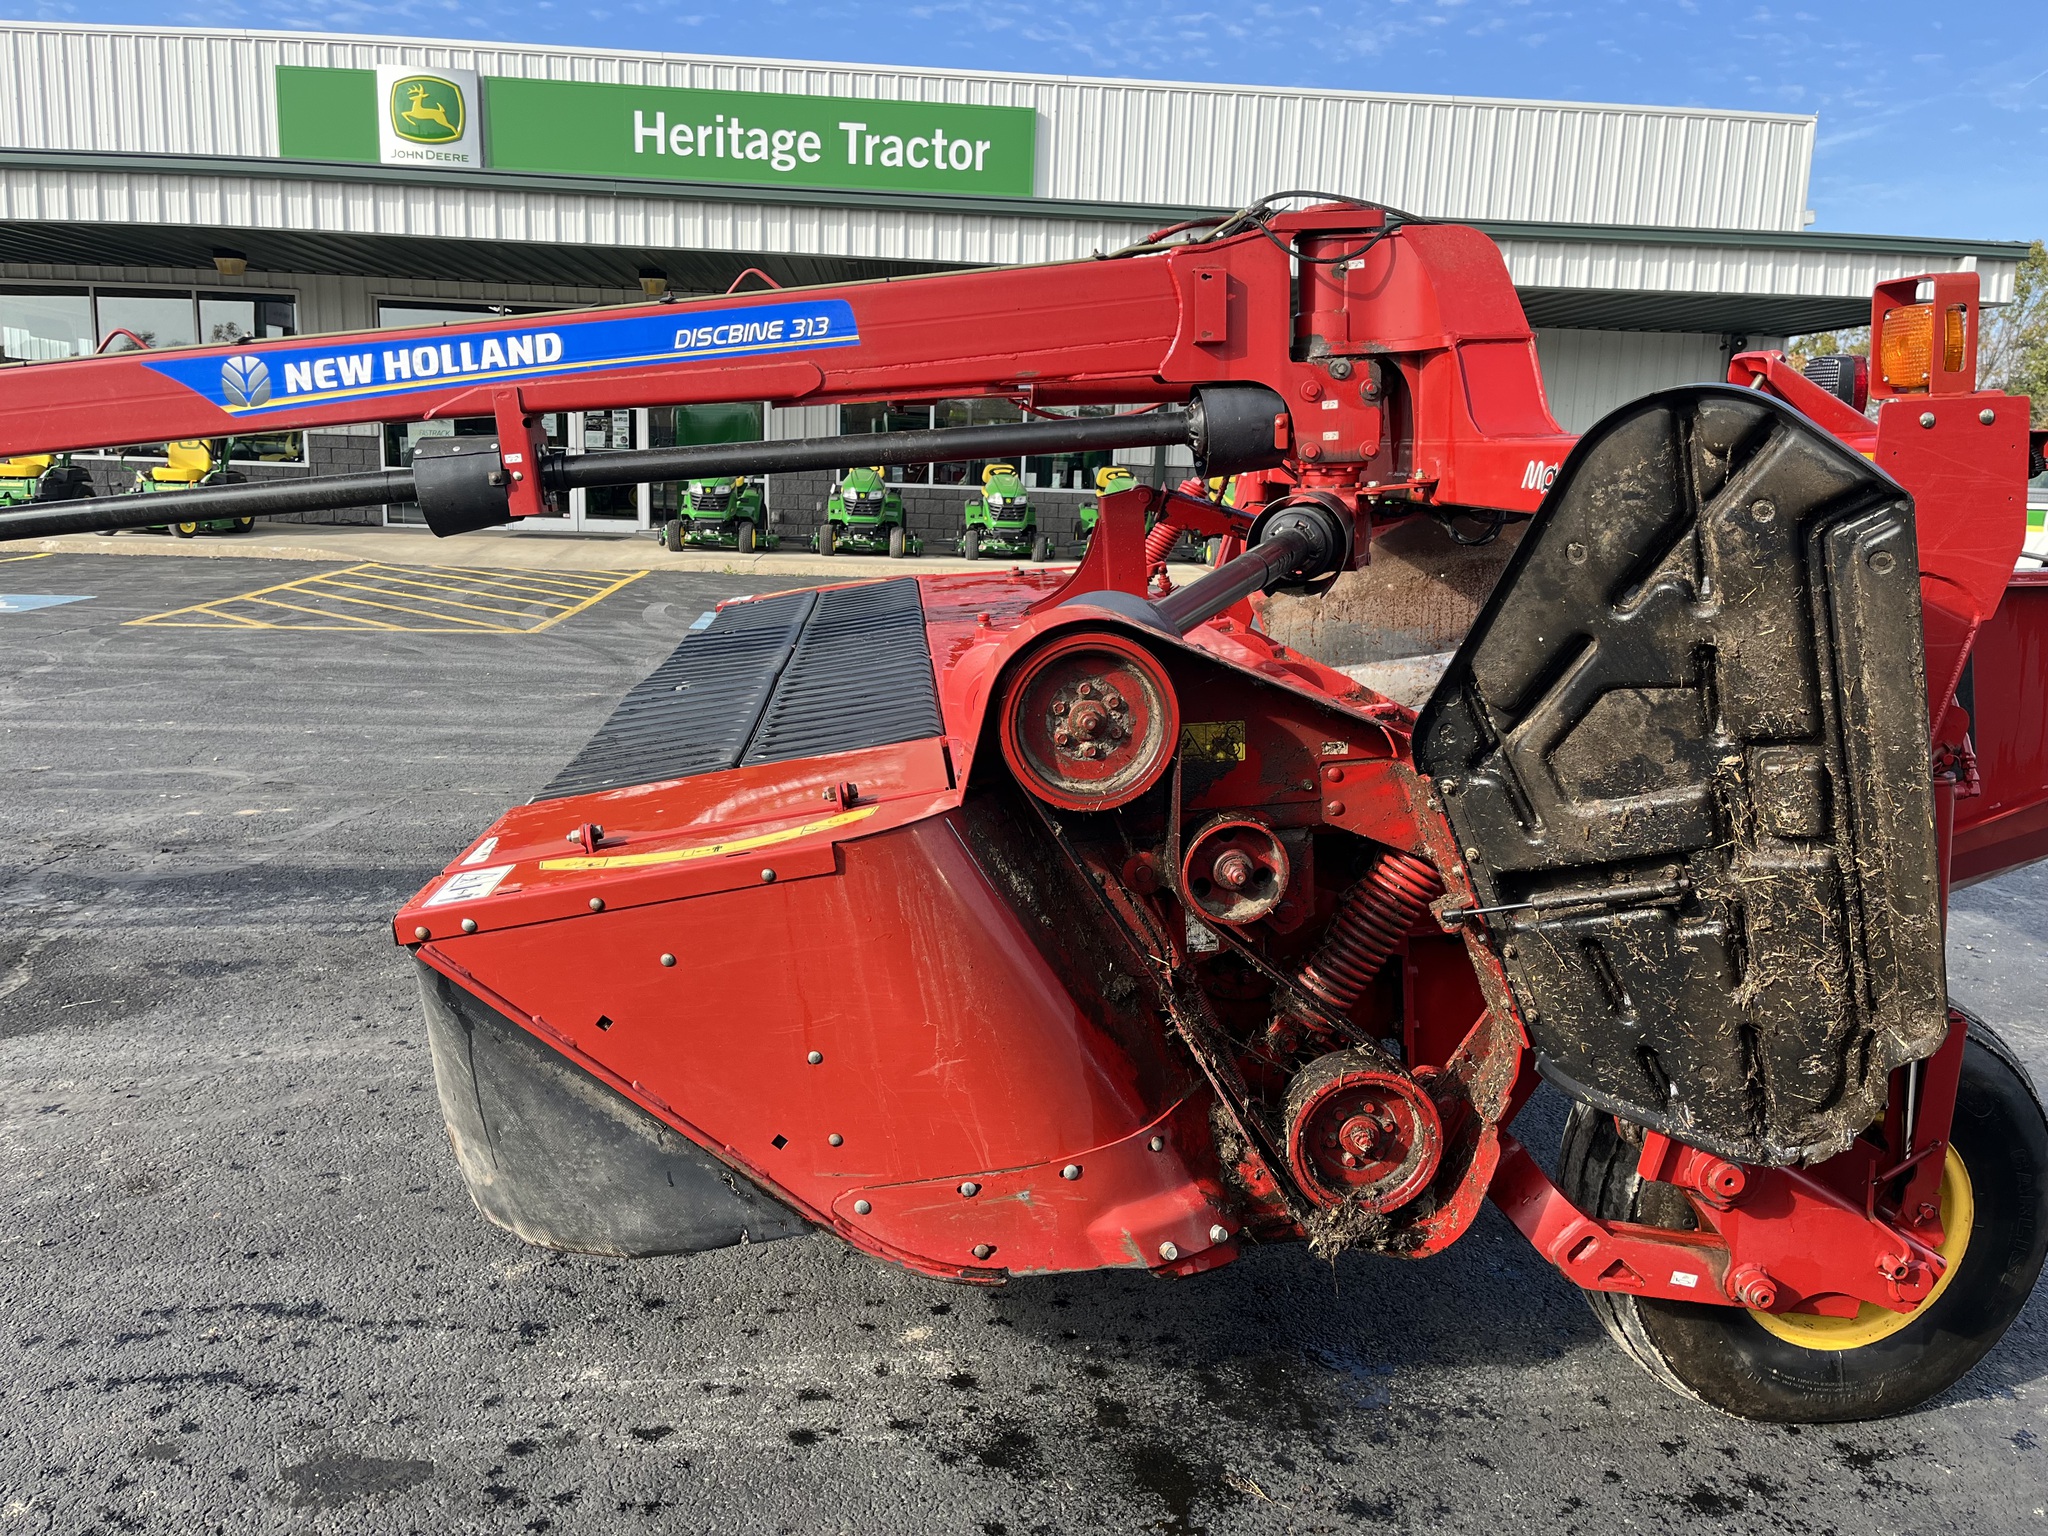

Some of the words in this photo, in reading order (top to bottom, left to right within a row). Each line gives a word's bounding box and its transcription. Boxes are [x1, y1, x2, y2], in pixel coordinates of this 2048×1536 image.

[391, 148, 424, 159] JOHN
[425, 150, 469, 162] DEERE
[633, 110, 822, 172] Heritage
[838, 121, 991, 171] Tractor
[674, 319, 784, 350] DISCBINE
[789, 316, 830, 339] 313
[283, 353, 373, 394] NEW
[382, 332, 563, 382] HOLLAND
